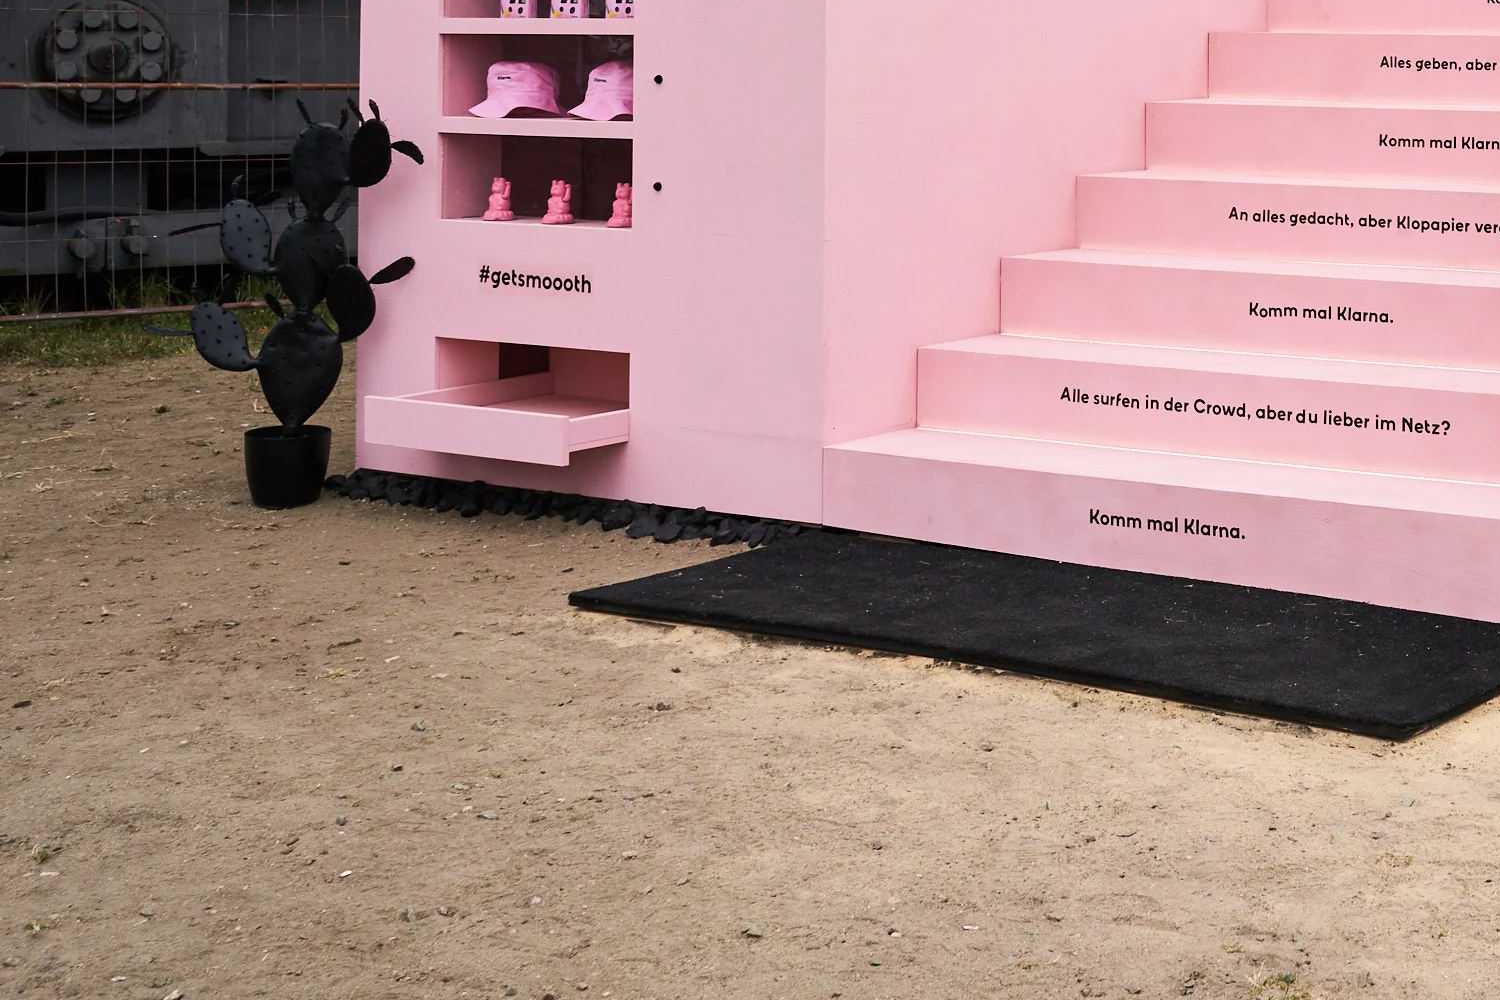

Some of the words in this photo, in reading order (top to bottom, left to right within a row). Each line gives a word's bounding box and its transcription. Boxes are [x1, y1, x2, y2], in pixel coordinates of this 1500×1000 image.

[1380, 55, 1412, 69] Alles
[1415, 57, 1462, 72] geben,
[1465, 58, 1498, 71] aber
[1379, 133, 1425, 148] Komm
[1429, 136, 1457, 149] mal
[1229, 206, 1249, 222] An
[1252, 209, 1286, 224] alles
[1289, 211, 1354, 230] gedacht,
[1358, 214, 1393, 229] aber
[1396, 215, 1471, 234] Klopapier
[478, 264, 592, 294] #getsmoooth
[1249, 301, 1298, 318] Komm
[1302, 305, 1332, 320] mal
[1337, 306, 1394, 324] Klarna.
[1060, 386, 1090, 404] Alle
[1093, 392, 1140, 410] surfen
[1145, 394, 1160, 410] in
[1163, 396, 1190, 413] der
[1193, 398, 1251, 421] Crowd,
[1255, 404, 1293, 422] aber
[1295, 408, 1318, 424] du
[1323, 409, 1370, 429] lieber
[1375, 414, 1396, 431] im
[1401, 416, 1451, 436] Netz?
[1089, 508, 1142, 529] Komm
[1147, 516, 1179, 533] mal
[1184, 518, 1246, 540] Klarna.
